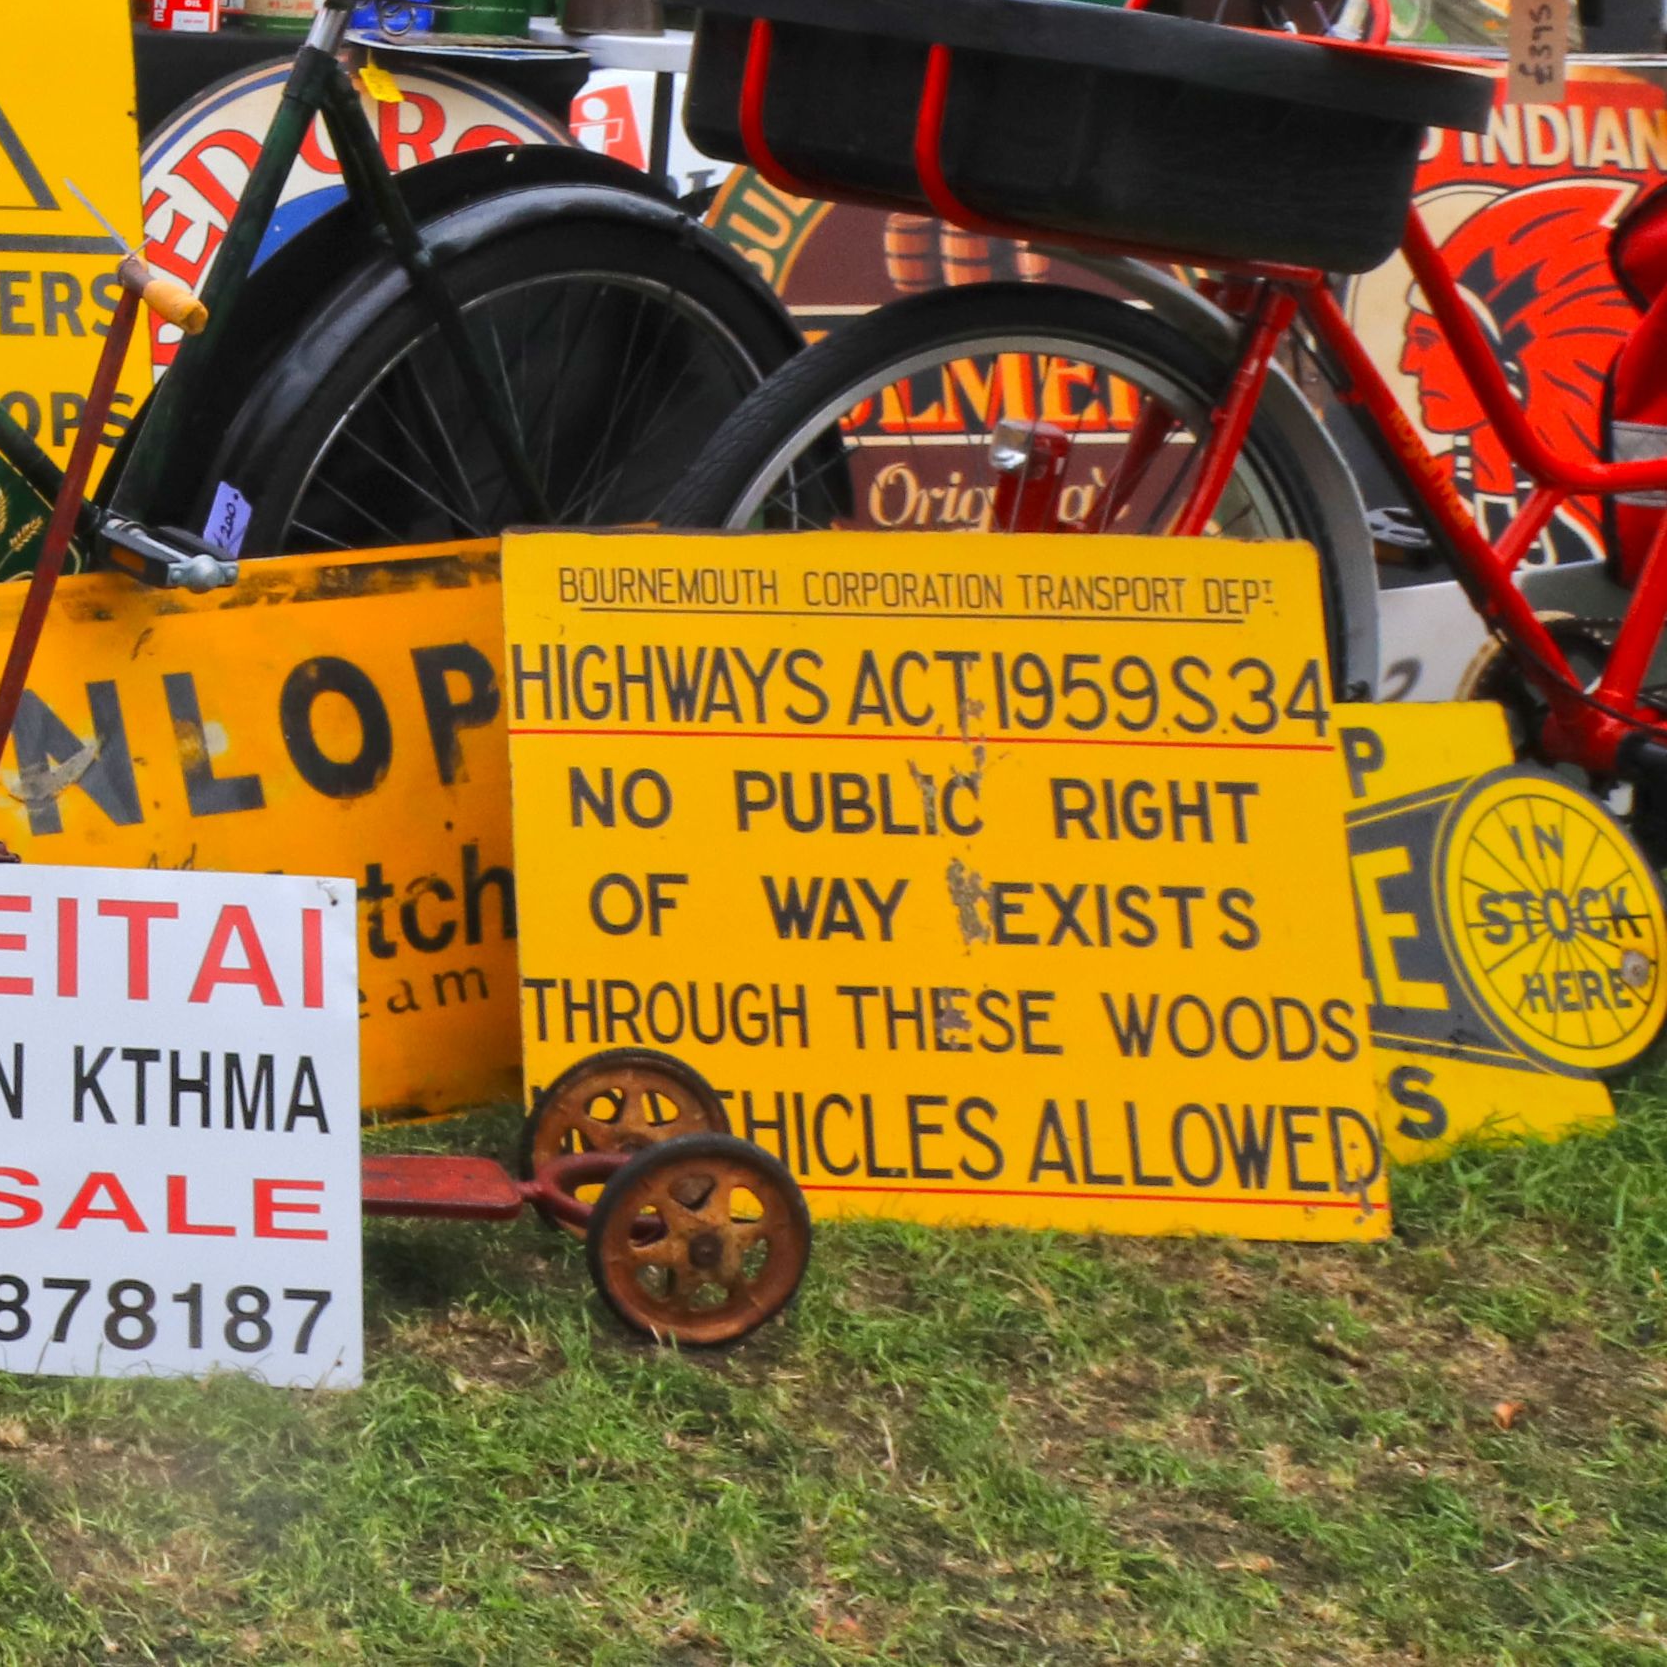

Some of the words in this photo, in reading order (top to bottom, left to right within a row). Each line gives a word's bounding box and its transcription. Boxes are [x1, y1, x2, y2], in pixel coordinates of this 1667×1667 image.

[558, 565, 778, 607] BOURNEMOUTH
[801, 569, 1010, 612] CORPORATION
[1017, 573, 1191, 615] TRANSPORT
[510, 641, 831, 727] HIGHWAYS
[847, 649, 981, 732] ACT
[569, 765, 672, 831] NO
[735, 769, 984, 837] PUBLIC
[1050, 777, 1260, 846] RIGHT
[1509, 823, 1564, 861] IN
[589, 871, 688, 936] OF
[761, 874, 910, 940] WAY
[991, 880, 1262, 951] EXISTS
[1477, 886, 1644, 946] STOCK
[521, 976, 808, 1051] THROUGH
[836, 985, 1063, 1056] THESE
[1099, 990, 1359, 1064] WOODS
[1522, 970, 1635, 1015] HERE
[72, 1045, 331, 1135] ΚΤΗΜΑ
[1028, 1096, 1383, 1192] ALLOWED
